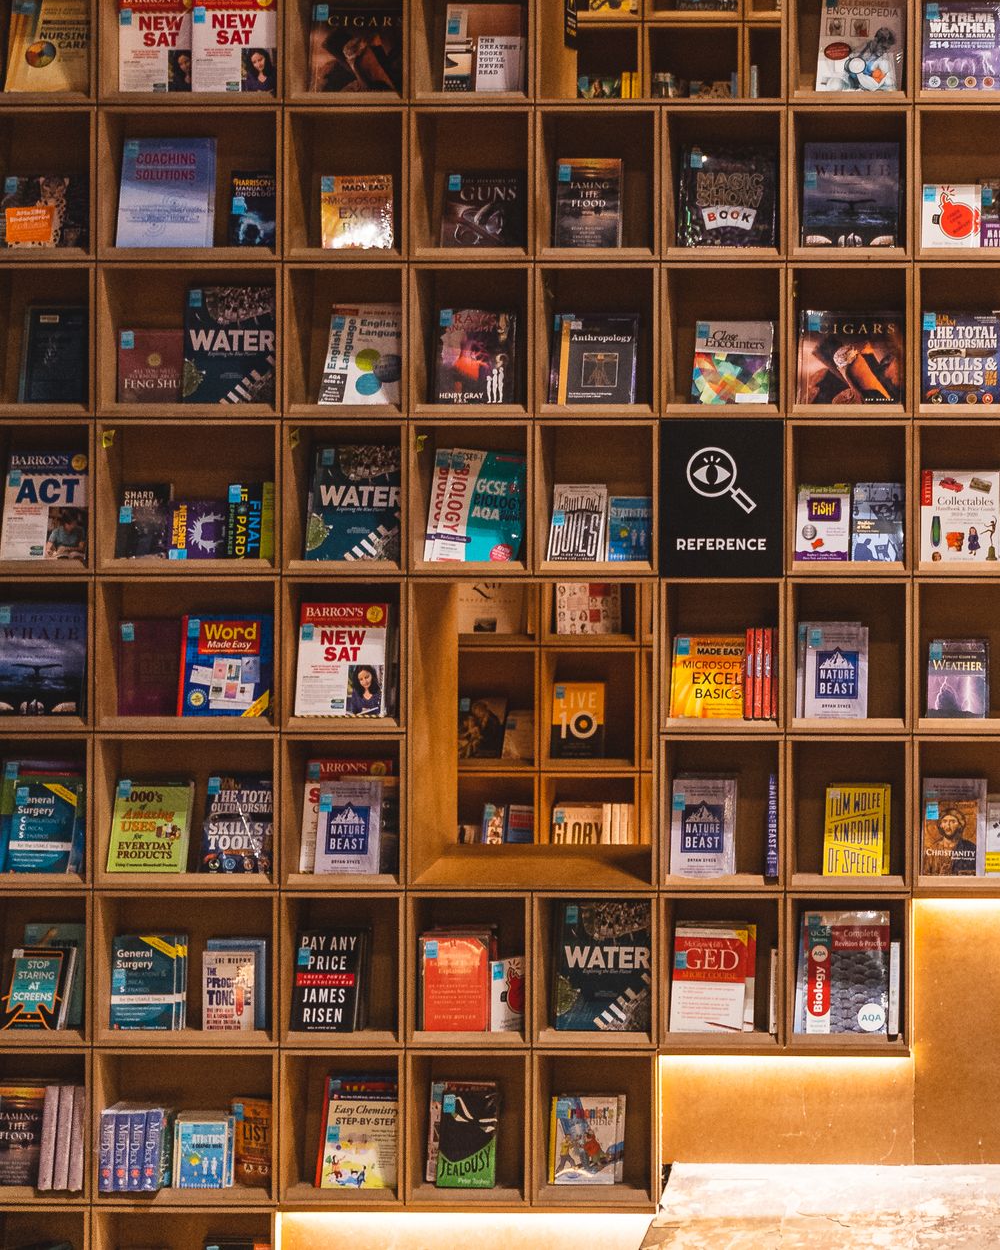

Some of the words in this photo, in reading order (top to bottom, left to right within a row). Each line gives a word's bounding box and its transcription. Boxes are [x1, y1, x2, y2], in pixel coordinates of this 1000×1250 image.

[139, 15, 184, 32] NEW
[211, 13, 257, 30] NEW
[930, 23, 995, 33] WEATHER
[143, 30, 179, 47] SAT
[216, 29, 252, 45] SAT
[136, 153, 196, 165] COACHING
[135, 169, 196, 181] SOLUTIONS
[696, 172, 763, 191] MAGIC
[460, 184, 517, 202] GUNS
[706, 209, 751, 224] BOOK
[818, 322, 896, 335] CIGARS
[929, 326, 955, 339] THE
[957, 325, 997, 339] TOTAL
[189, 329, 274, 352] WATER
[571, 332, 632, 344] Anthropology
[712, 330, 739, 342] Close
[927, 339, 997, 349] OUTDOORSMAN
[927, 357, 982, 372] SKILLS
[985, 357, 997, 372] &
[928, 371, 984, 387] TOOLS
[439, 391, 462, 399] HENRY
[464, 392, 484, 400] GRAY
[16, 479, 80, 504] ACT
[476, 479, 509, 495] GCSE
[320, 485, 401, 507] WATER
[937, 495, 994, 507] Collectables
[471, 508, 498, 520] AQA
[676, 538, 767, 551] REFERENCE
[305, 605, 364, 617] BARRON'S
[204, 624, 257, 641] Word
[320, 630, 366, 646] NEW
[325, 646, 361, 662] SAT
[933, 659, 982, 672] WEATHER
[691, 672, 743, 685] EXCEL
[819, 668, 855, 680] NATURE
[819, 682, 854, 695] BEAST
[560, 692, 597, 709] LIVE
[18, 805, 54, 817] Surgery
[120, 820, 156, 832] USES
[331, 824, 366, 836] NATURE
[834, 821, 879, 845] KINGDOM
[330, 838, 364, 850] BEAST
[685, 837, 719, 849] BEAST
[302, 936, 328, 952] PAY
[331, 936, 357, 951] ANY
[866, 939, 887, 947] Practice
[307, 955, 347, 971] PRICE
[565, 946, 651, 969] WATER
[686, 948, 739, 970] GED
[27, 960, 50, 969] STOP
[18, 972, 55, 980] STARING
[29, 982, 40, 990] AT
[812, 966, 824, 1014] Biology
[12, 993, 52, 1002] SCREENS
[303, 988, 345, 1004] JAMES
[303, 1007, 343, 1023] RISEN
[334, 1105, 353, 1117] Easy
[355, 1105, 398, 1117] Chemistry
[439, 1145, 491, 1178] JEALOUSY
